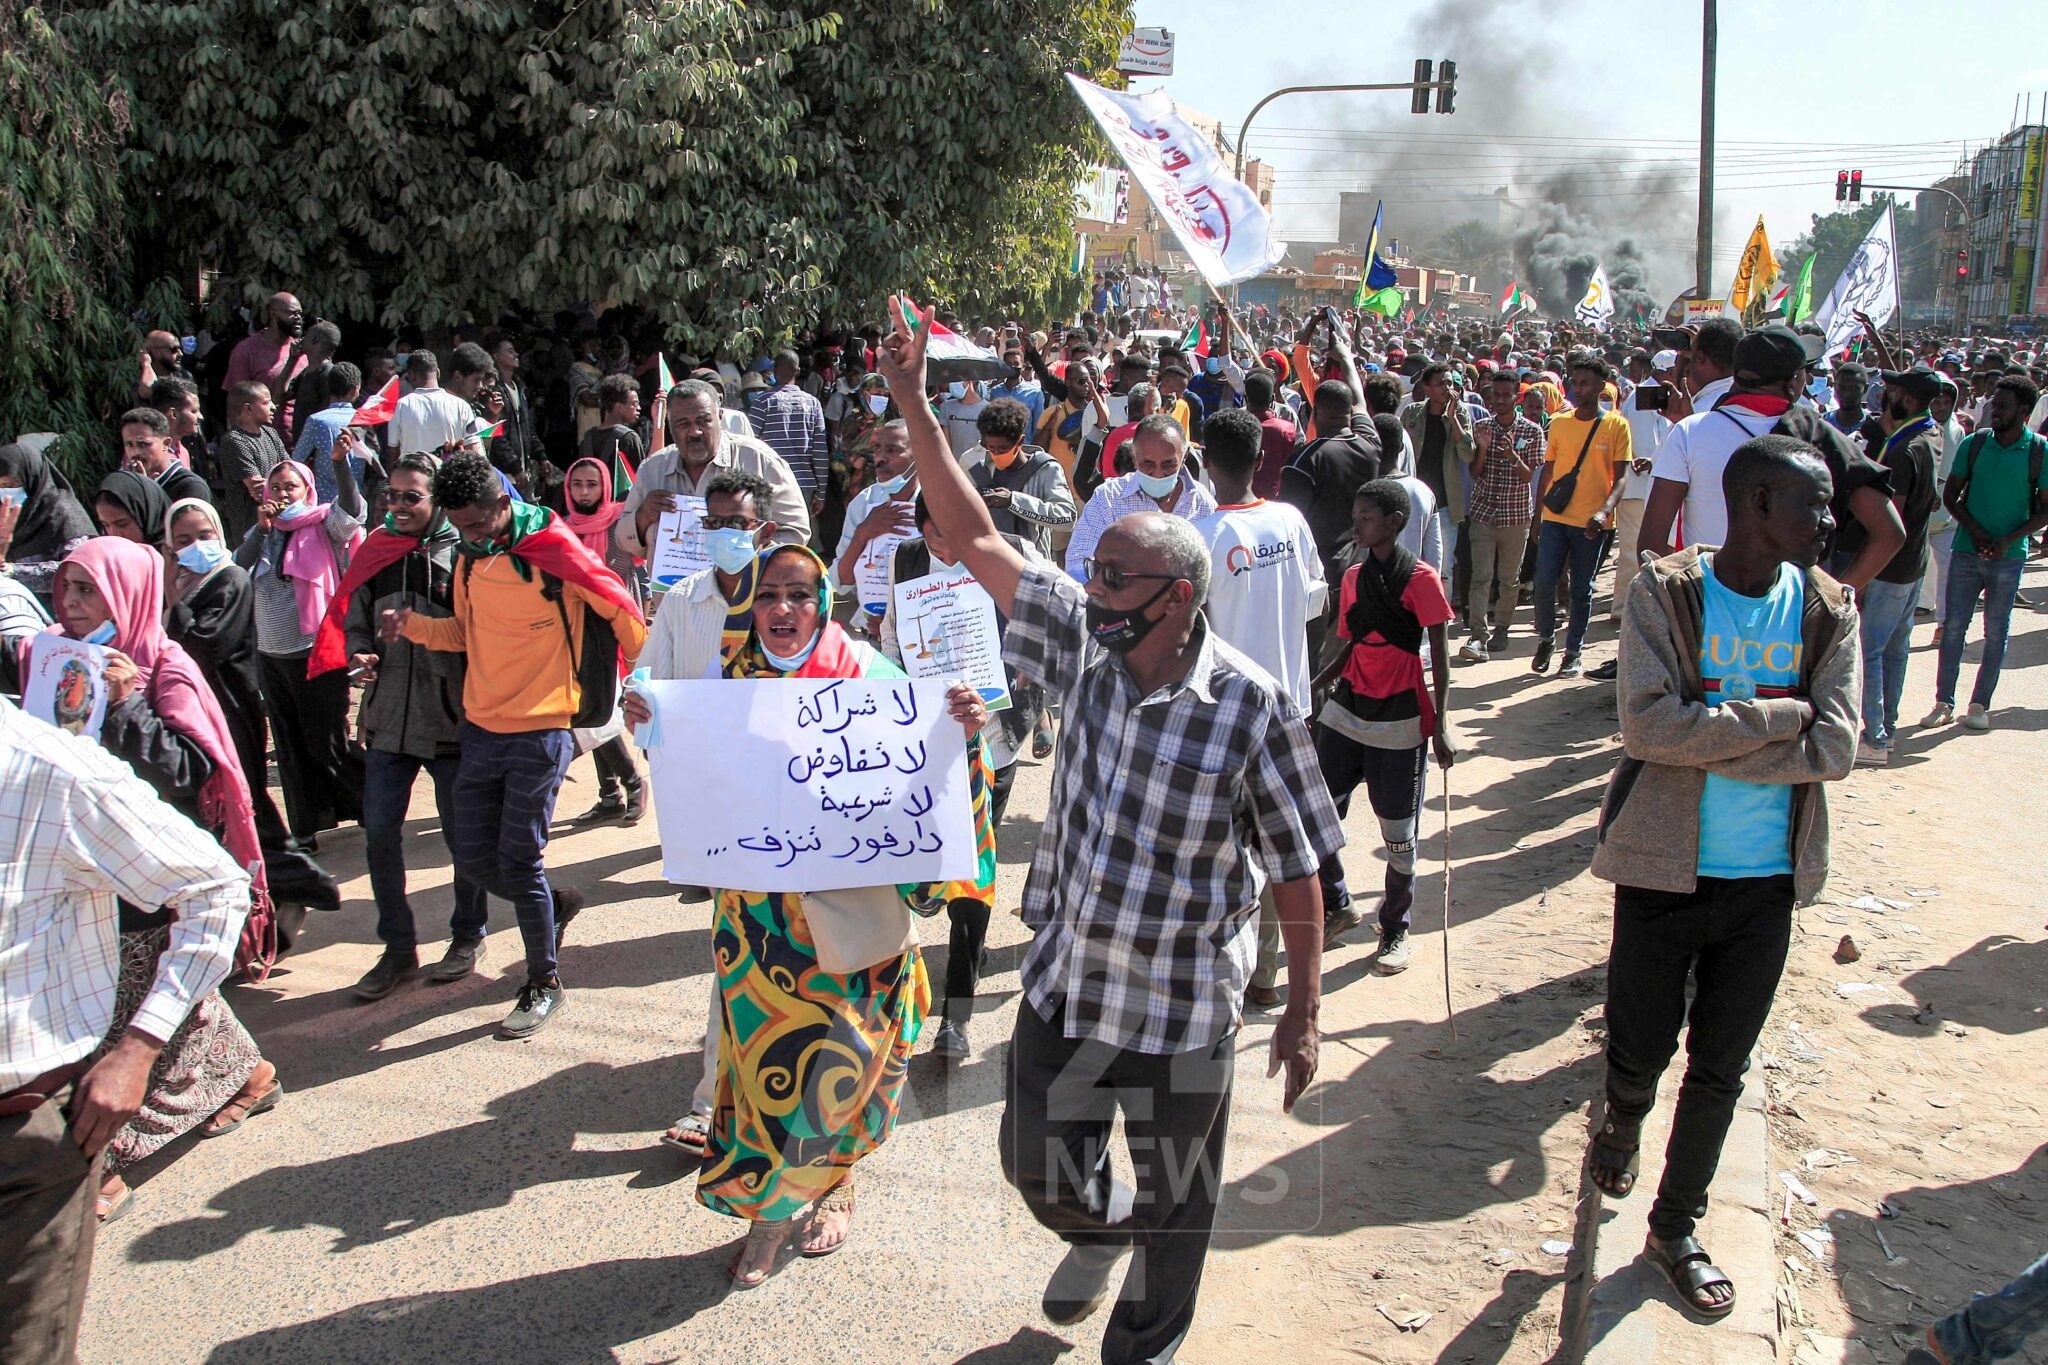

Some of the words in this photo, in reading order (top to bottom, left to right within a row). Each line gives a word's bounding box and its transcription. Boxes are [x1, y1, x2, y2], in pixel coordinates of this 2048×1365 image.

[946, 575, 978, 591] حامو
[1698, 634, 1803, 674] UCCI
[798, 680, 877, 733] شراكة
[893, 682, 919, 726] لا
[788, 736, 890, 783] تفاوض
[895, 740, 927, 774] لا
[821, 786, 892, 822] شرعية
[903, 786, 933, 817] لا
[737, 825, 822, 867] تنزف
[828, 821, 944, 863] دارفور
